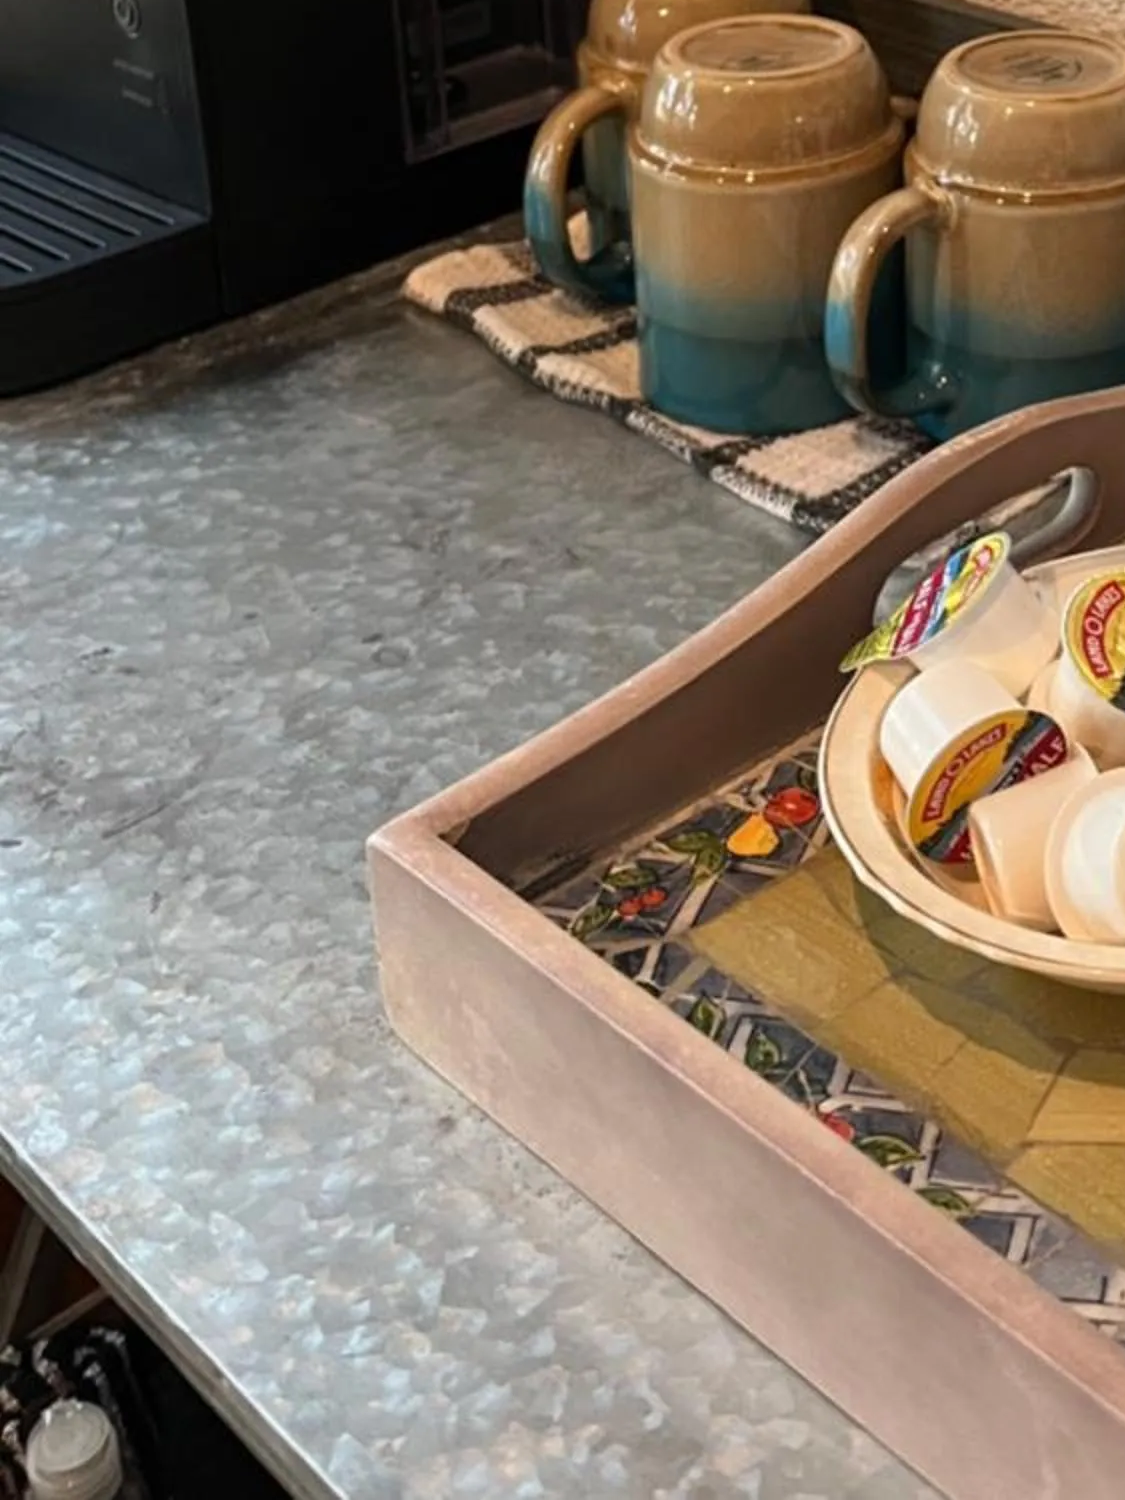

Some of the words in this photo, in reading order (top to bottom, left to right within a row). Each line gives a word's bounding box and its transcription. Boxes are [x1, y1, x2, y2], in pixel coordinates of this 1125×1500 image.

[1094, 584, 1122, 619] LAKES
[1085, 616, 1102, 635] O
[1086, 636, 1110, 674] LAND
[1026, 735, 1064, 774] ALF
